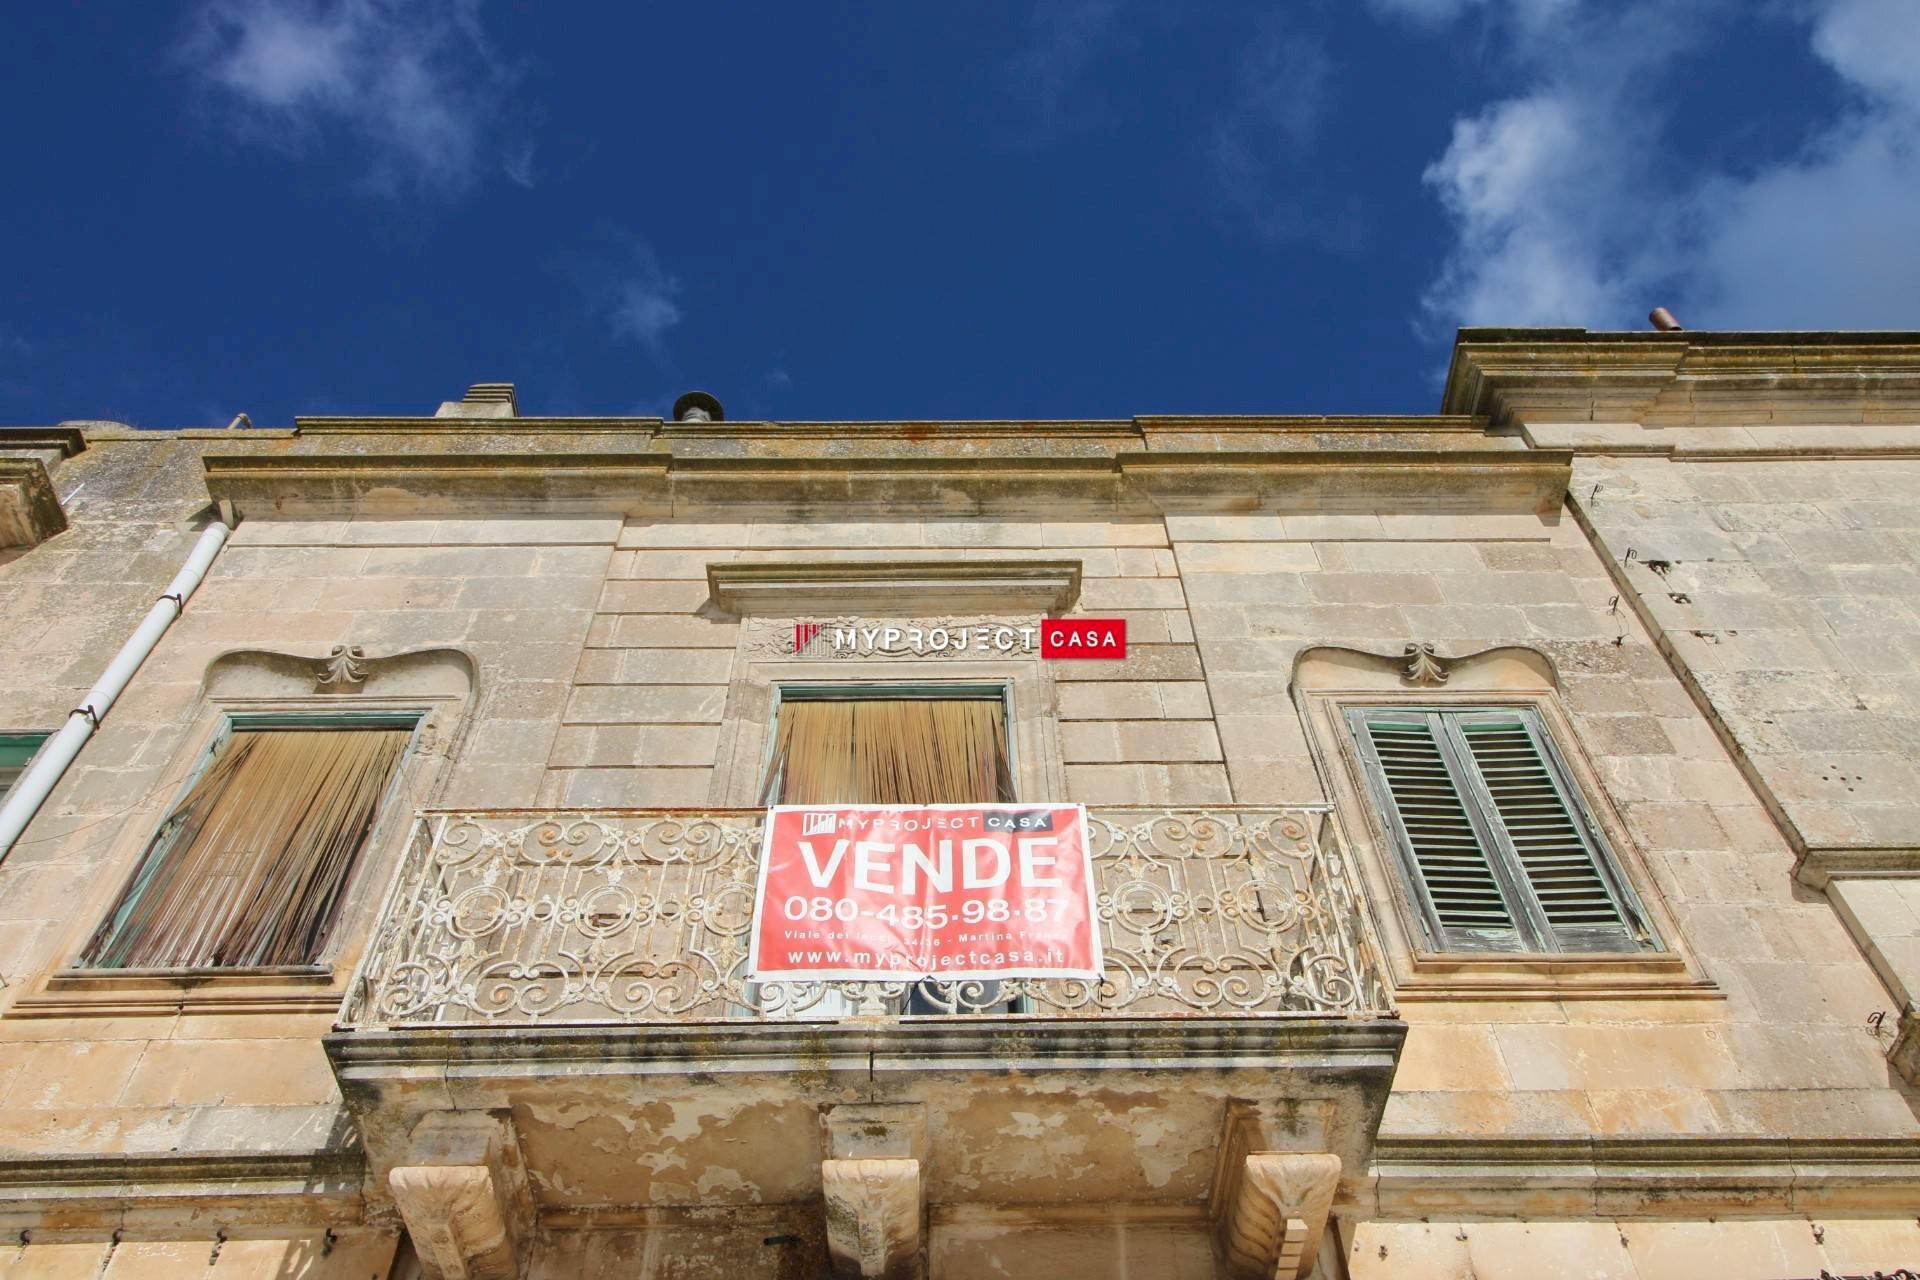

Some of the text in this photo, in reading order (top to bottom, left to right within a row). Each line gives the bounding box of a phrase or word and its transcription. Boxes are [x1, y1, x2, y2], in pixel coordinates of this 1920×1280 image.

[836, 627, 1117, 650] MYPROJECT CASA
[838, 816, 1047, 832] MYPROJECT CASA
[799, 838, 1062, 895] VENDE
[784, 930, 820, 939] Viale
[827, 930, 849, 939] dei
[958, 931, 1012, 943] Martina
[788, 950, 1064, 968] www.myprojectcasa.it
